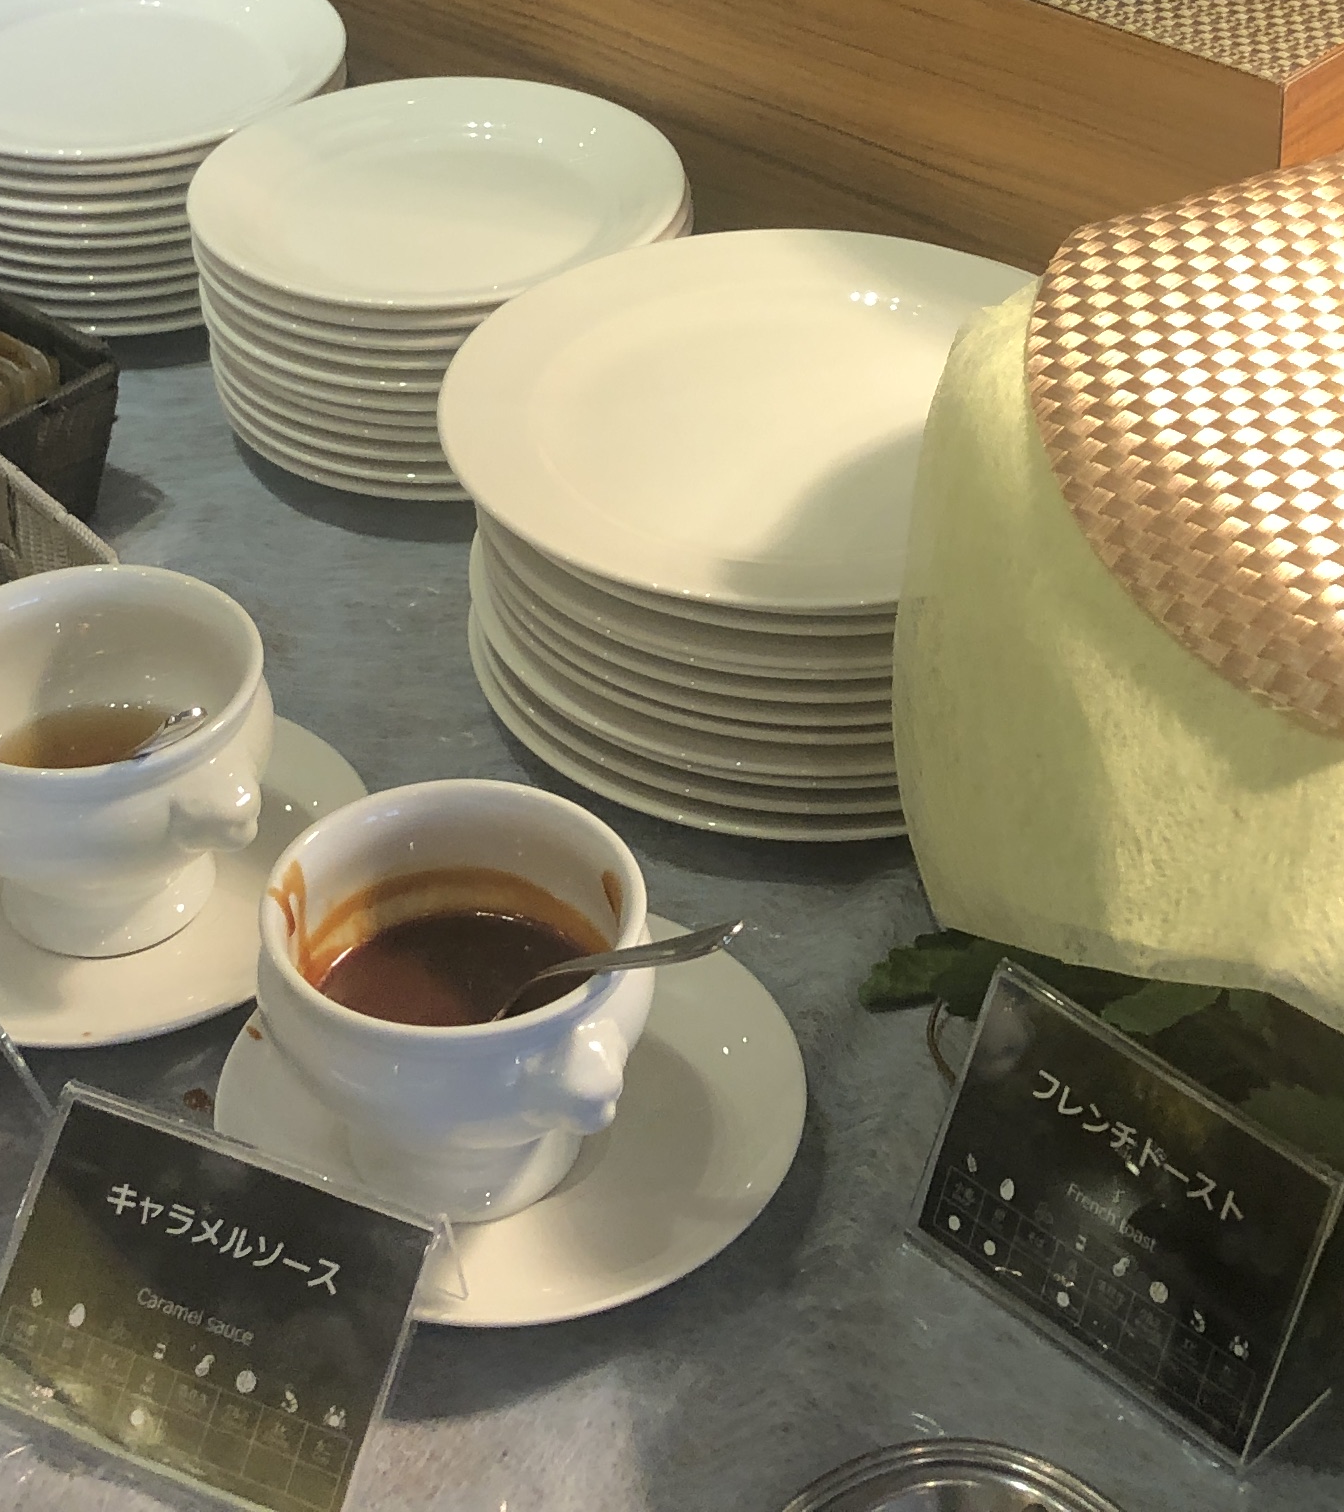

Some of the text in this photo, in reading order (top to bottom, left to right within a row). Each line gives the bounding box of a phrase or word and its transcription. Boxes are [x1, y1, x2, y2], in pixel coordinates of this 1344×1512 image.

[107, 1182, 341, 1295] キャラメルソース
[1066, 1181, 1158, 1254] French toast
[136, 1287, 255, 1346] Caramel sauce
